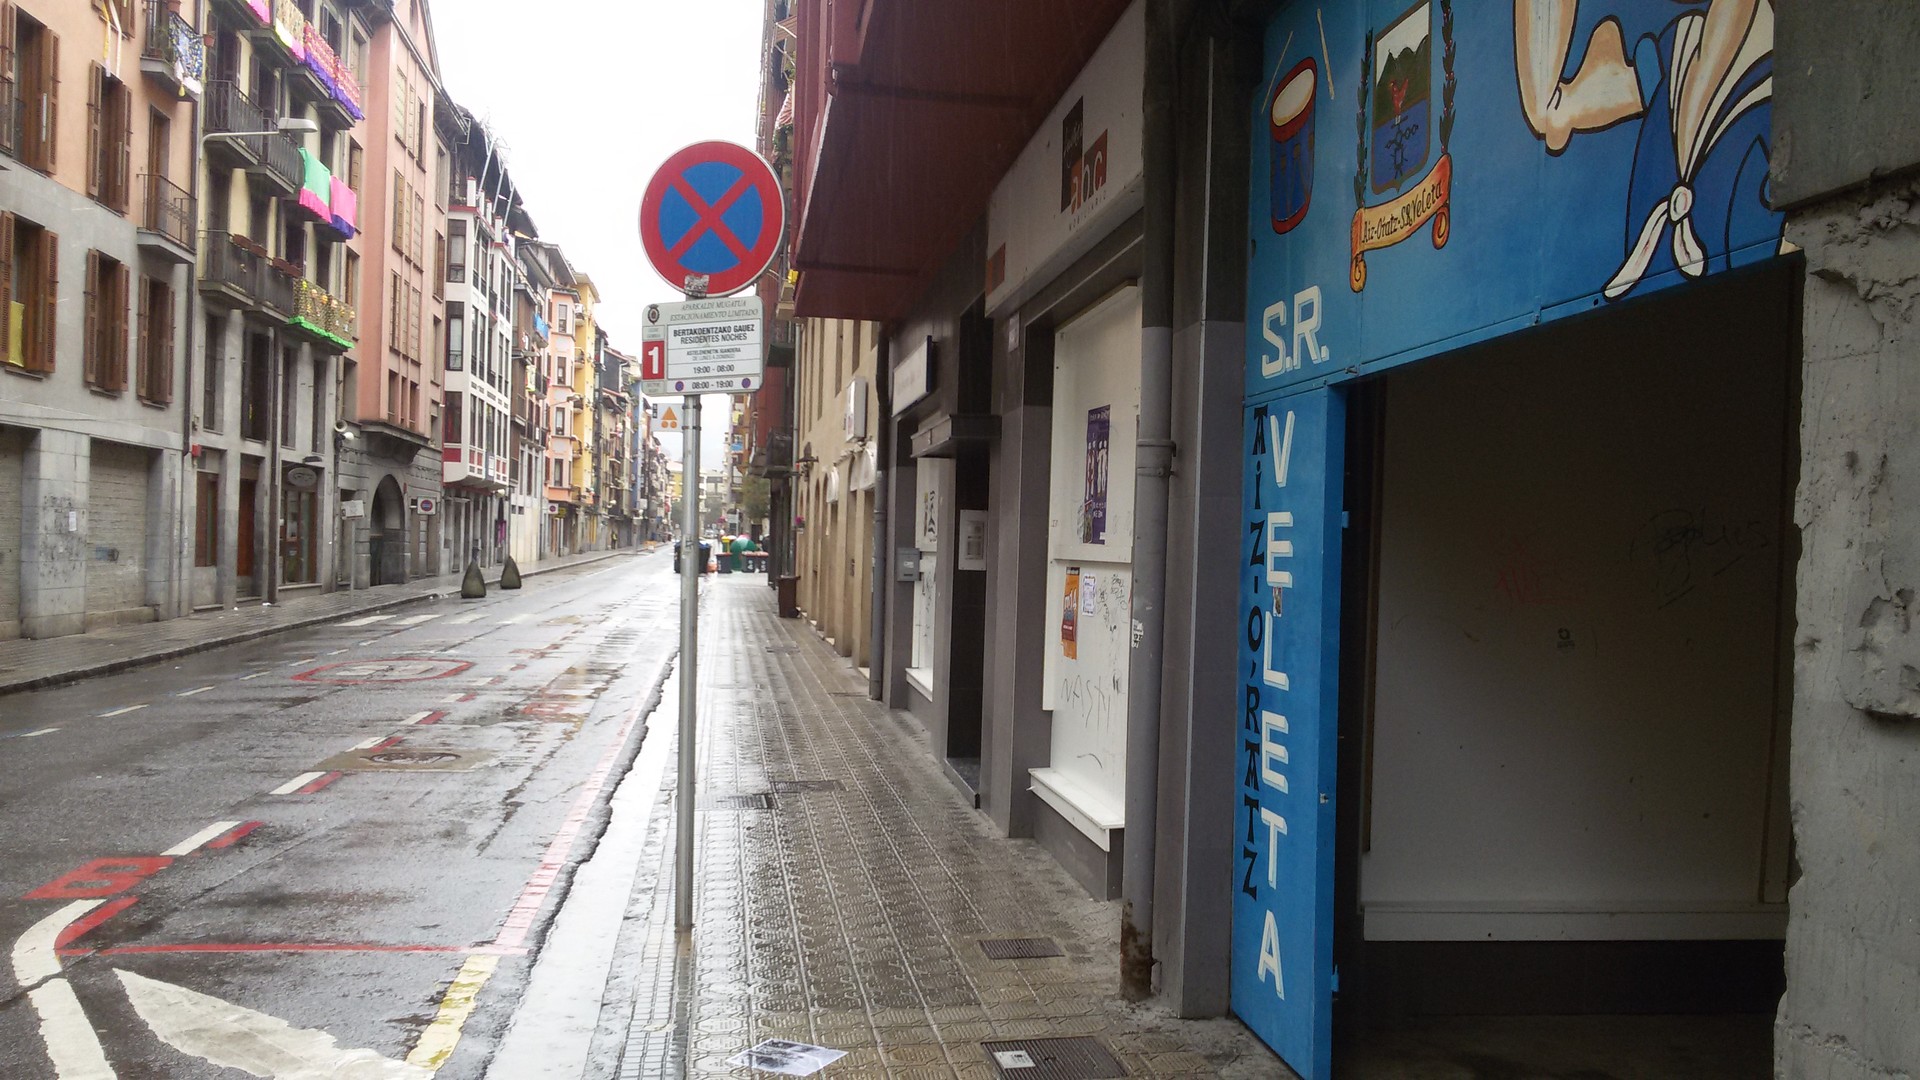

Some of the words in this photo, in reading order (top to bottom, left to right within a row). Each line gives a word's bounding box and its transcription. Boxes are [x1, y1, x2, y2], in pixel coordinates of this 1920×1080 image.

[681, 301, 715, 311] APARKALDI
[716, 299, 747, 309] MUGATUA
[670, 310, 727, 321] ESTACIONAMIENTO
[728, 308, 759, 318] LIMITADO
[673, 326, 732, 337] BERTAKOENTZAKO
[733, 324, 755, 333] GAUEZ
[1262, 285, 1330, 379] S.R.
[681, 335, 720, 344] RESIDENTES
[721, 333, 748, 341] NOCHES
[648, 346, 659, 375] 1
[693, 365, 711, 374] 19:00
[716, 364, 735, 373] 08:00
[691, 380, 710, 389] 08:00
[716, 380, 734, 388] 19:00
[1257, 410, 1296, 1001] VELETA
